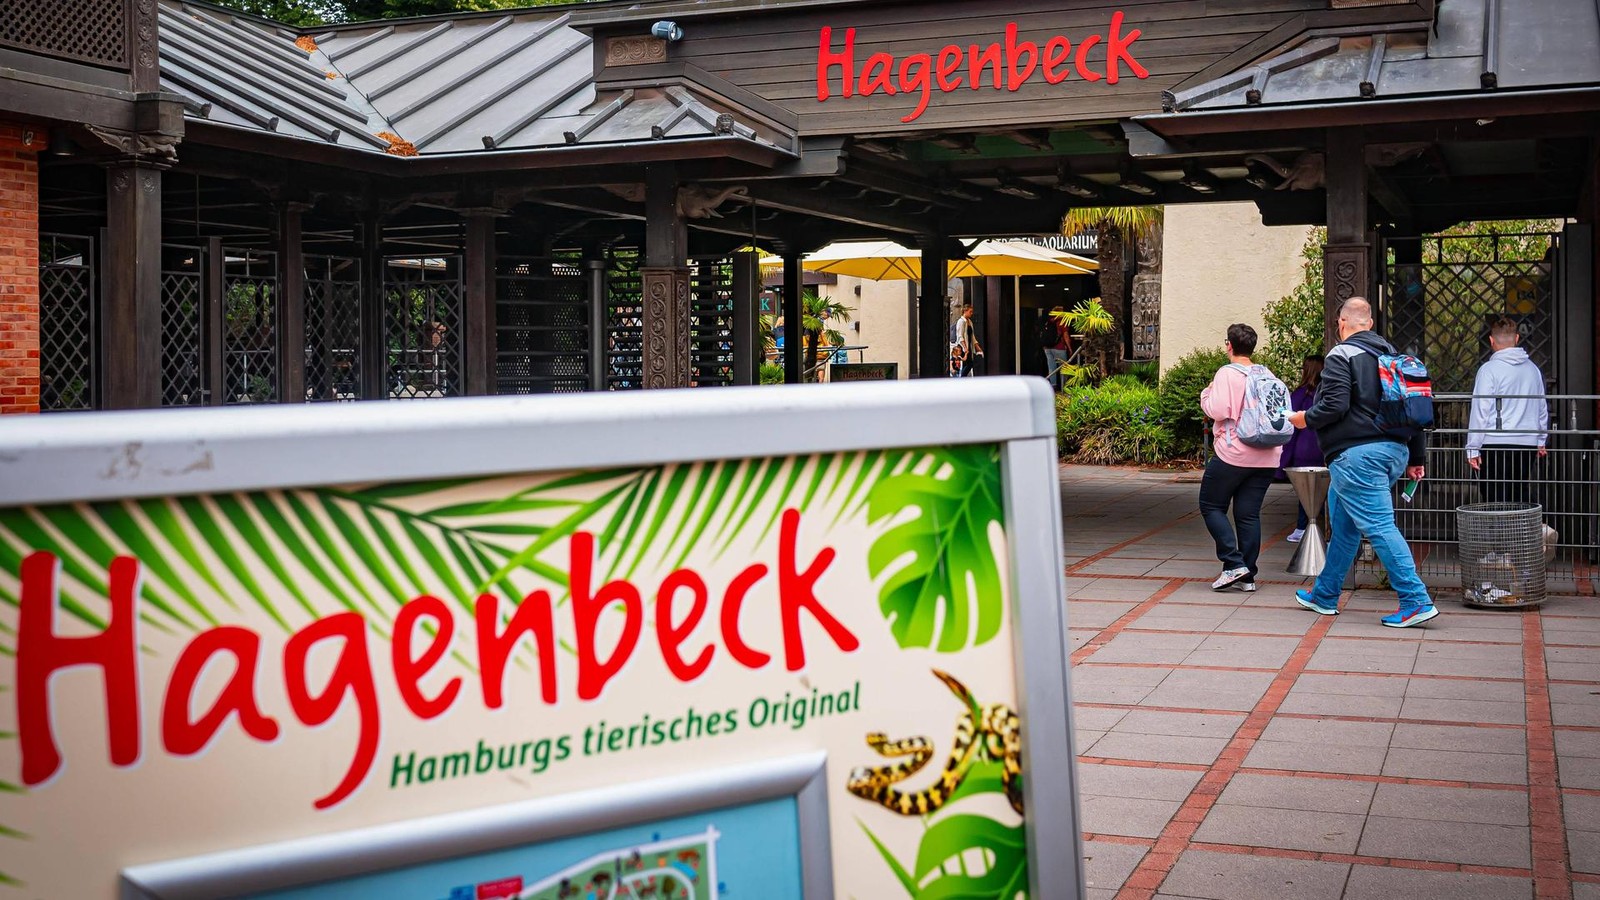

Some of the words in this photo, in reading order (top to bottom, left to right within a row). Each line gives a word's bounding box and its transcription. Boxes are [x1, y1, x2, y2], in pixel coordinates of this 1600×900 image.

[815, 11, 1149, 123] Hagenbeck
[14, 508, 860, 809] Hagenbeck
[389, 733, 571, 789] Hamburgs
[583, 708, 738, 757] tierisches
[748, 681, 862, 729] Original
